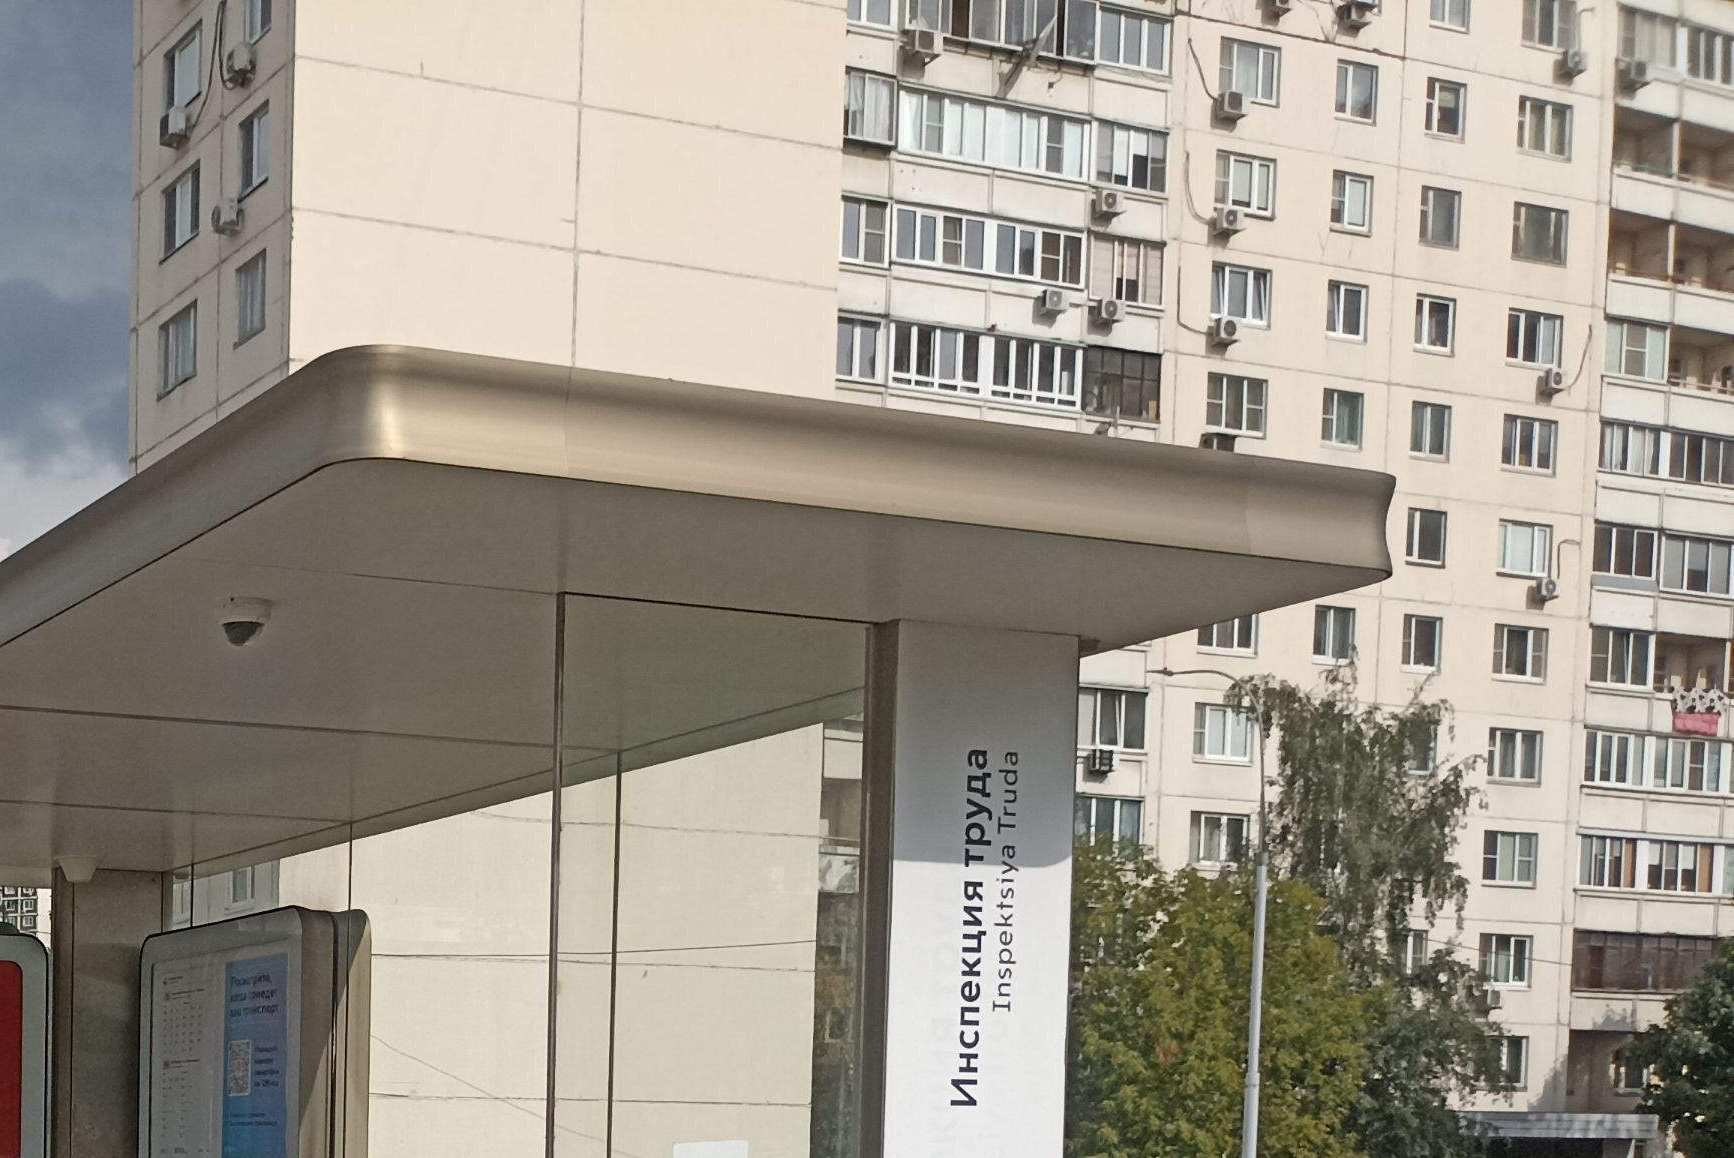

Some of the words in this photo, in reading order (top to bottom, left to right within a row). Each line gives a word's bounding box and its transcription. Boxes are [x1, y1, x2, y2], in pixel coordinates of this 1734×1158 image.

[963, 748, 993, 868] труда
[997, 750, 1019, 834] Truda
[950, 880, 989, 1107] Инспекция
[992, 843, 1019, 1013] Inspektsiya
